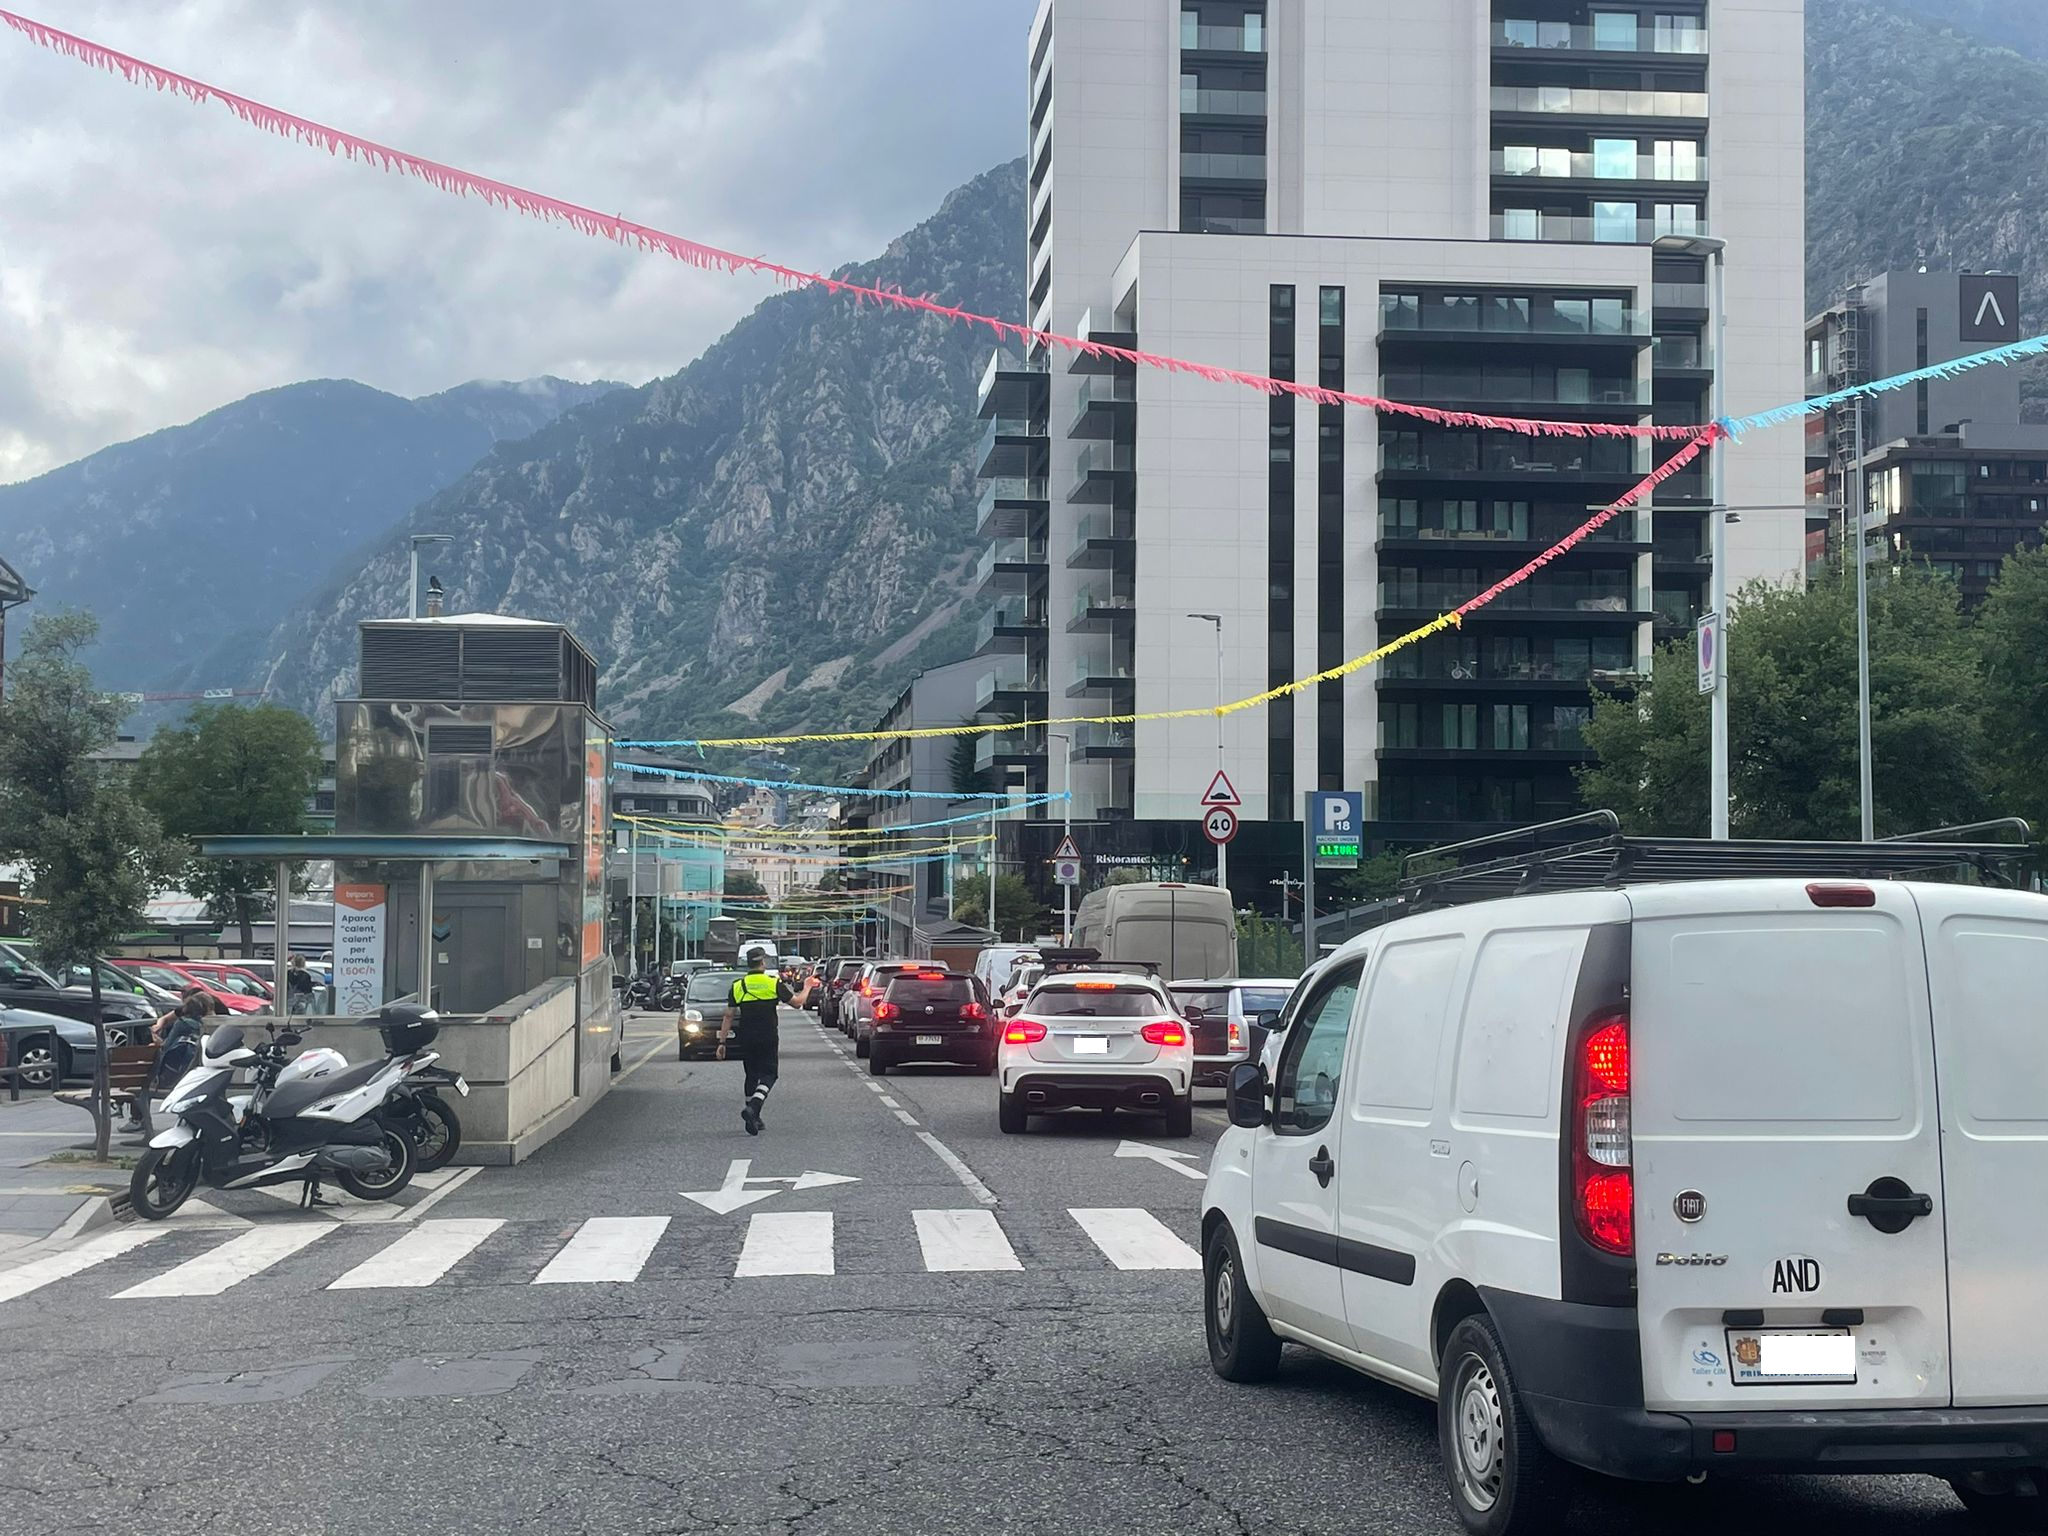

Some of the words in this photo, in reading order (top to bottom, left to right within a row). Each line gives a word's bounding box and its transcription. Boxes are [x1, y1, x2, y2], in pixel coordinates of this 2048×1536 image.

[1324, 797, 1351, 831] P
[1209, 818, 1231, 831] 40
[1336, 821, 1351, 831] 18
[1096, 854, 1146, 864] Ristorante
[341, 914, 376, 924] Aparca
[350, 947, 366, 955] per
[342, 956, 375, 964] només
[1681, 1198, 1700, 1214] FIAT
[1772, 1259, 1820, 1293] AND
